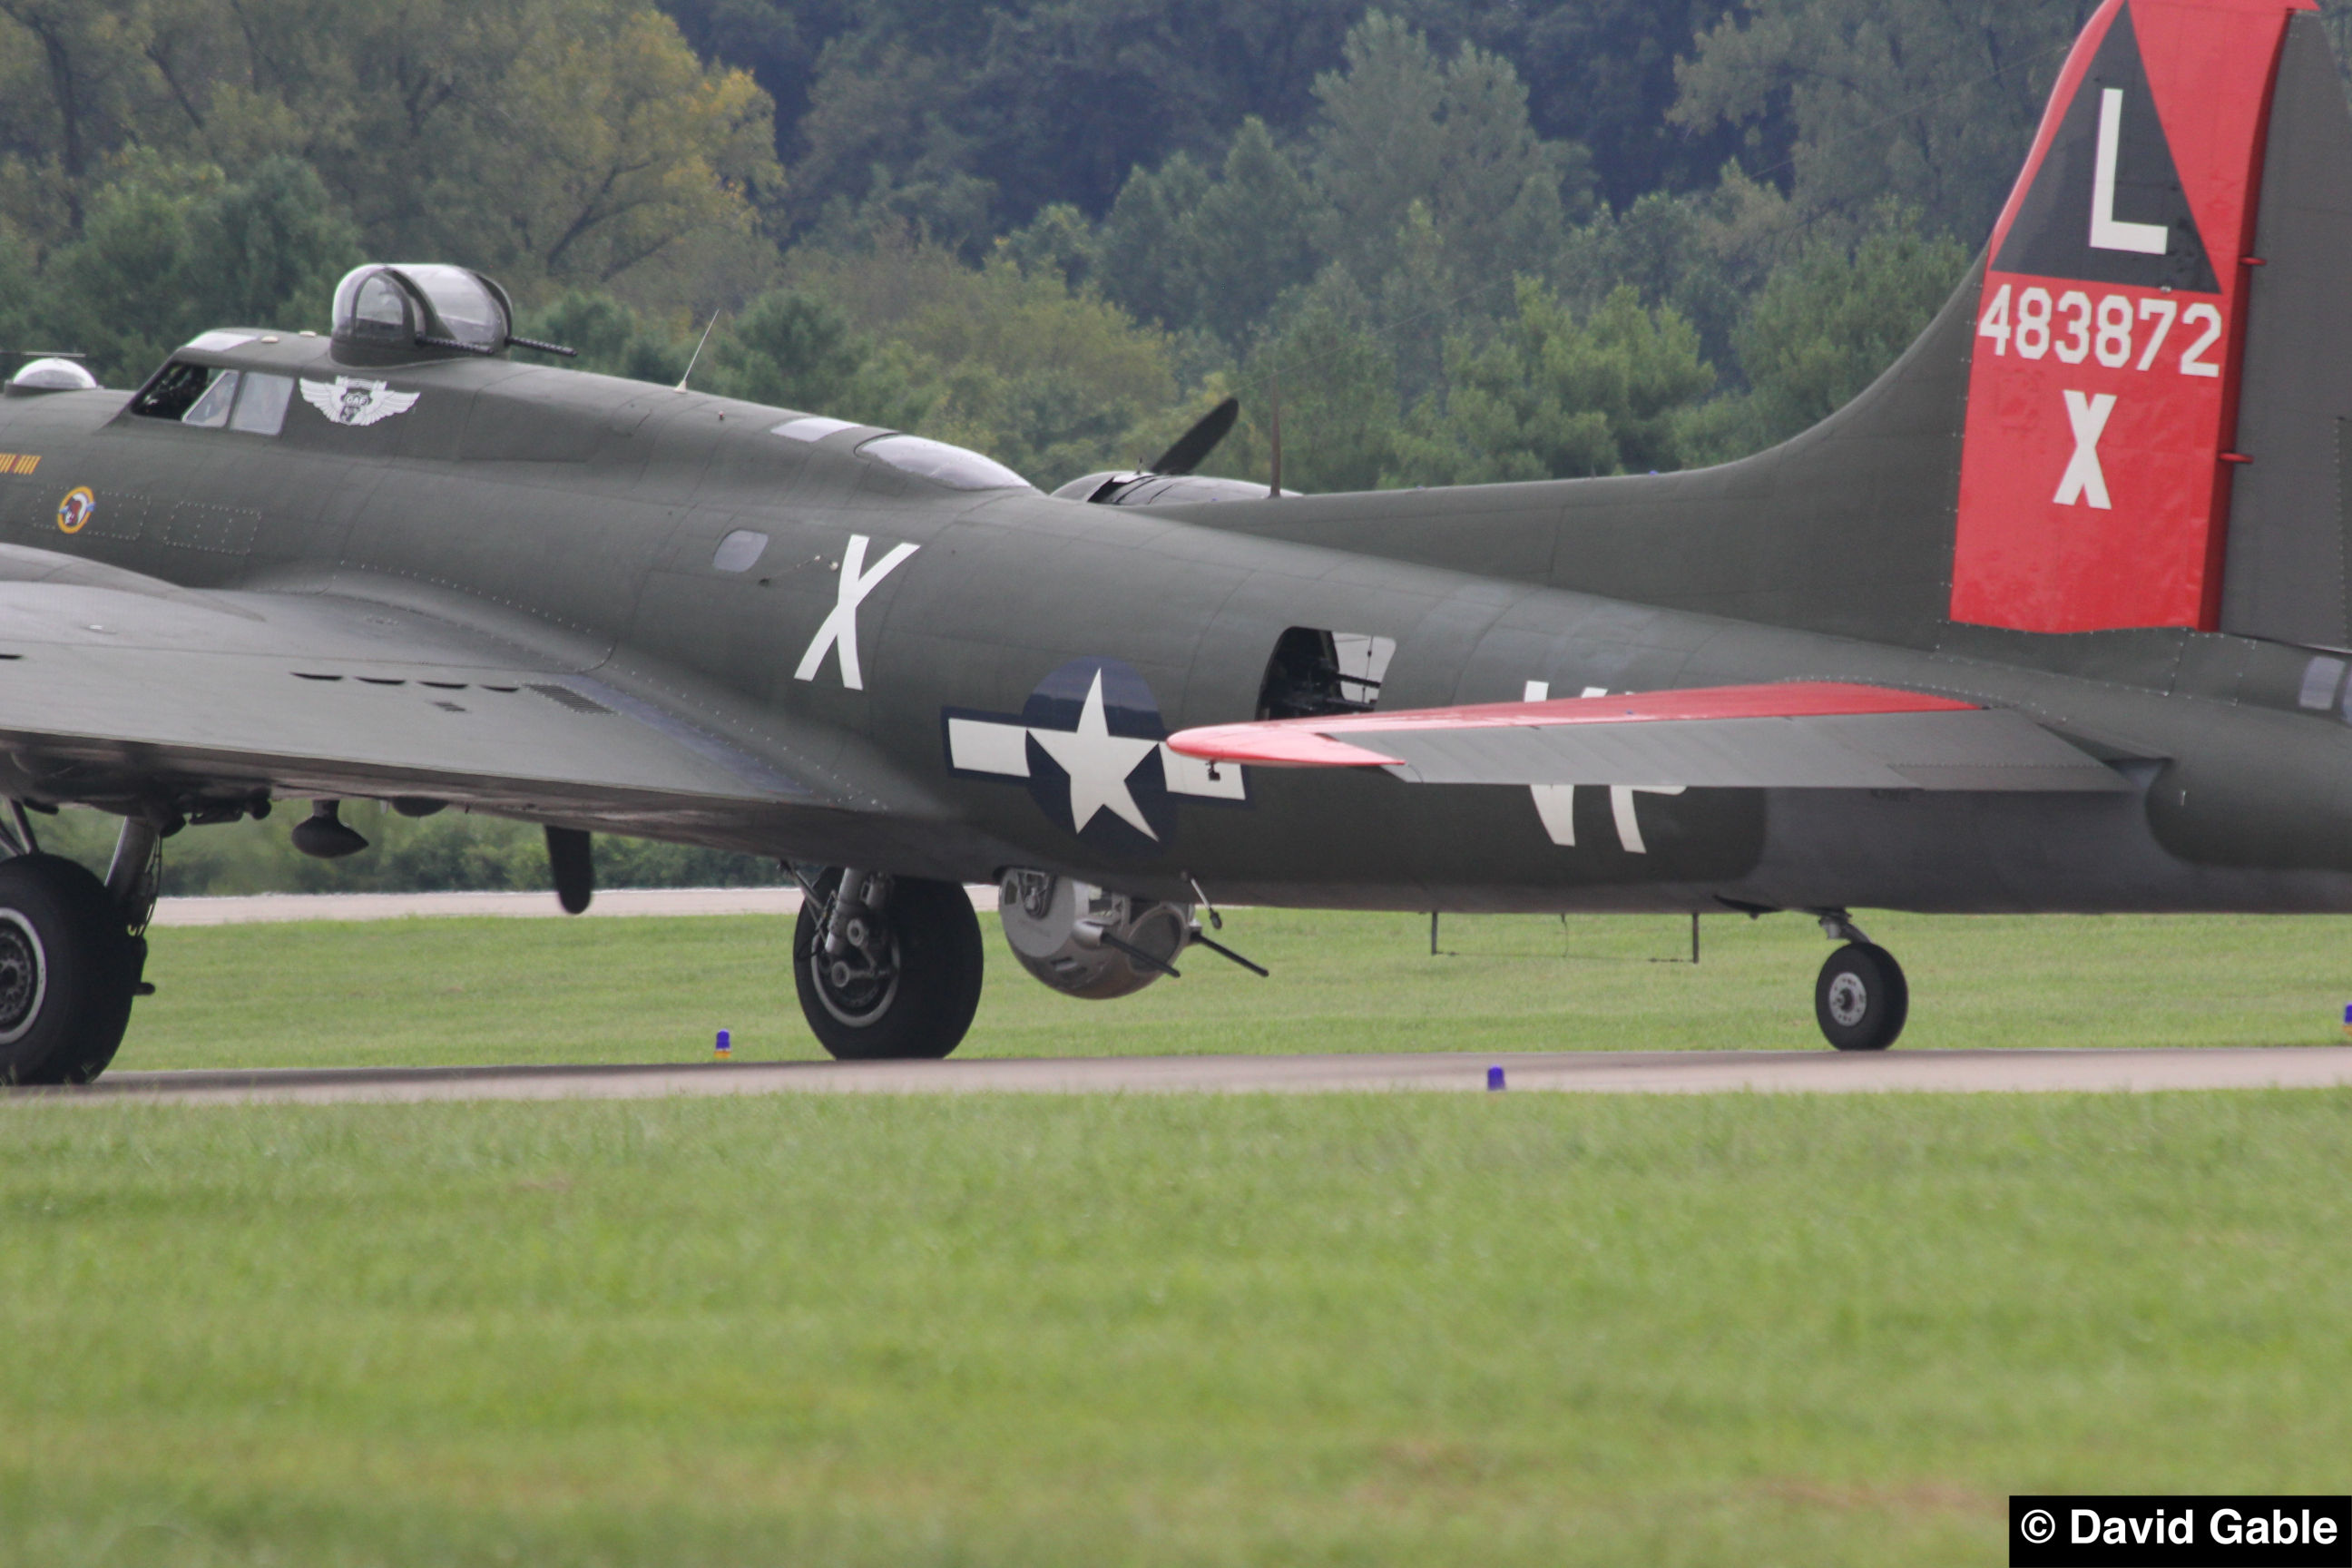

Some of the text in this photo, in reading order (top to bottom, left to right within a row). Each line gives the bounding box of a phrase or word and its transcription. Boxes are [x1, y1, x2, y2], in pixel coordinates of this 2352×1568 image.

[2090, 88, 2169, 254] L
[1978, 284, 2222, 377] 483872
[2053, 388, 2118, 510] X
[793, 534, 922, 691] X
